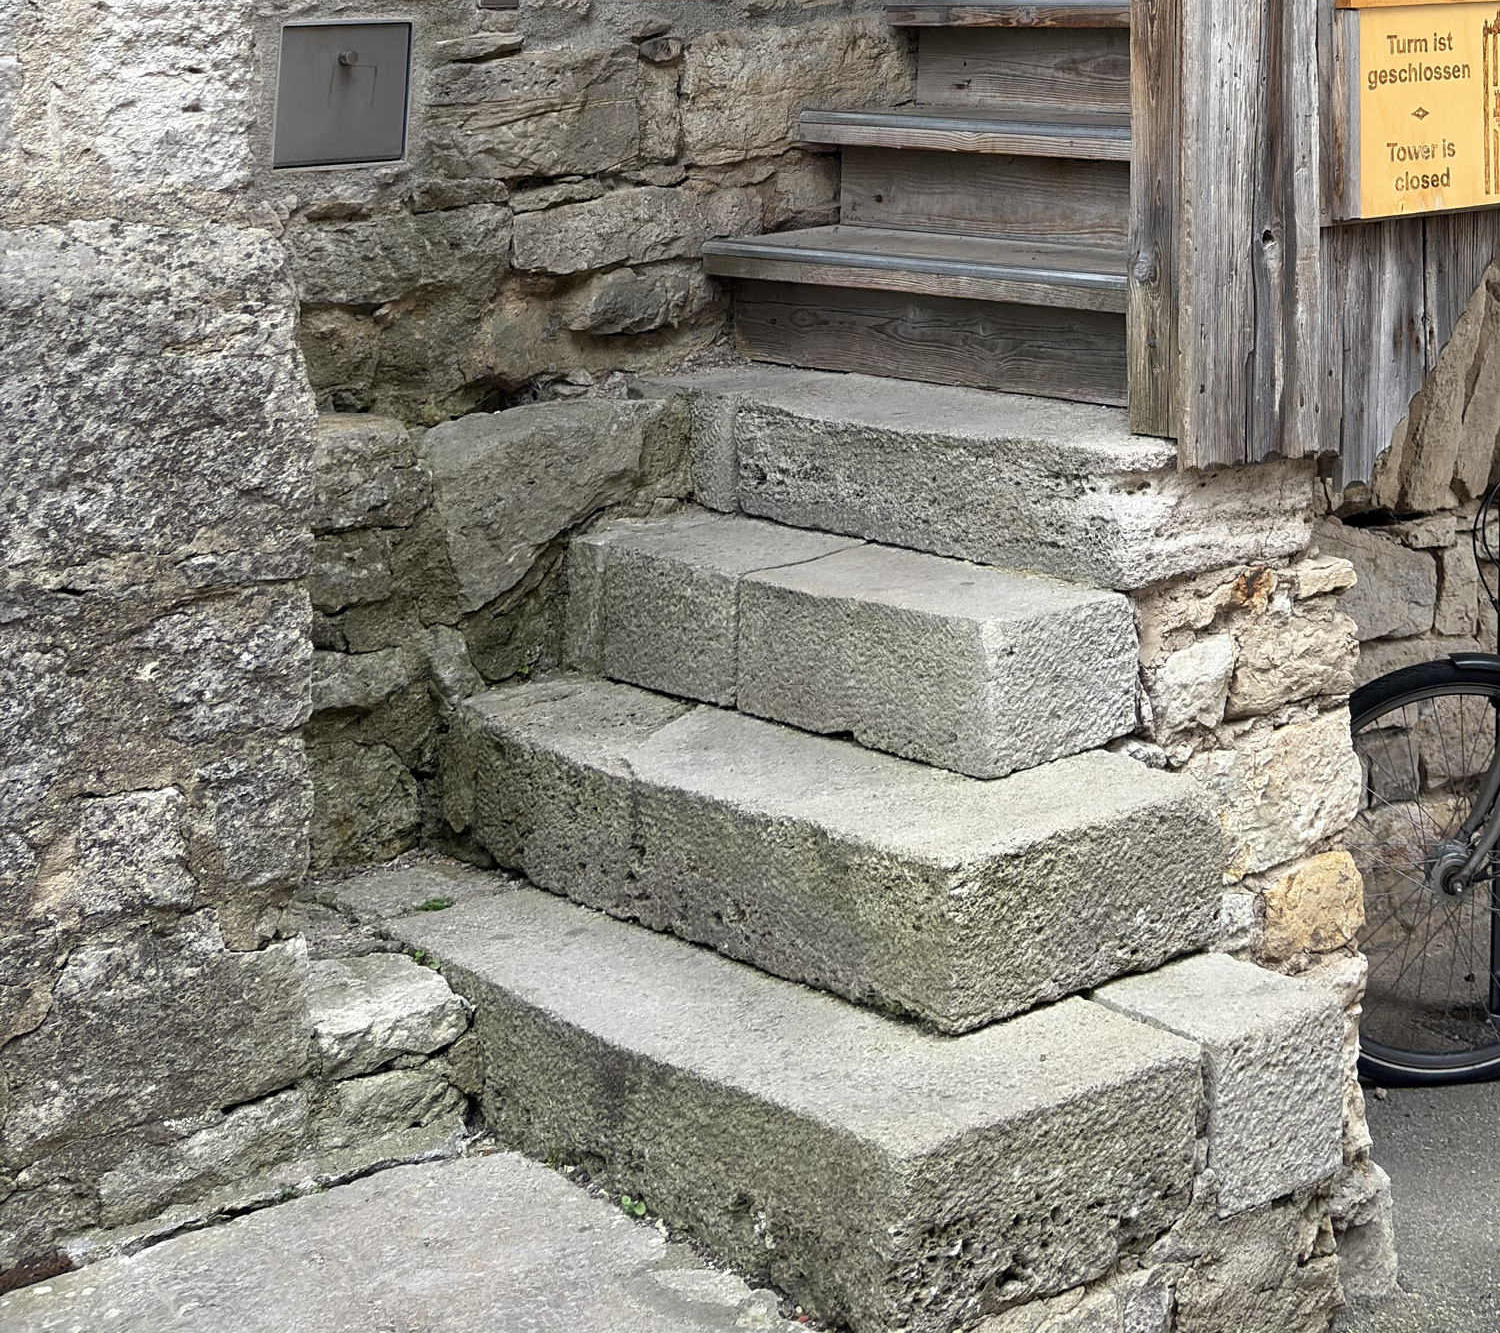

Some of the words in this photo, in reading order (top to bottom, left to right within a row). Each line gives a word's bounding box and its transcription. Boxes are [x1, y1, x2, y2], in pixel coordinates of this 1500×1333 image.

[1386, 34, 1429, 55] Turm
[1433, 32, 1454, 52] ist
[1367, 62, 1471, 91] geschlossen
[1386, 141, 1438, 162] Tower
[1442, 139, 1456, 158] is
[1394, 167, 1451, 192] closed
